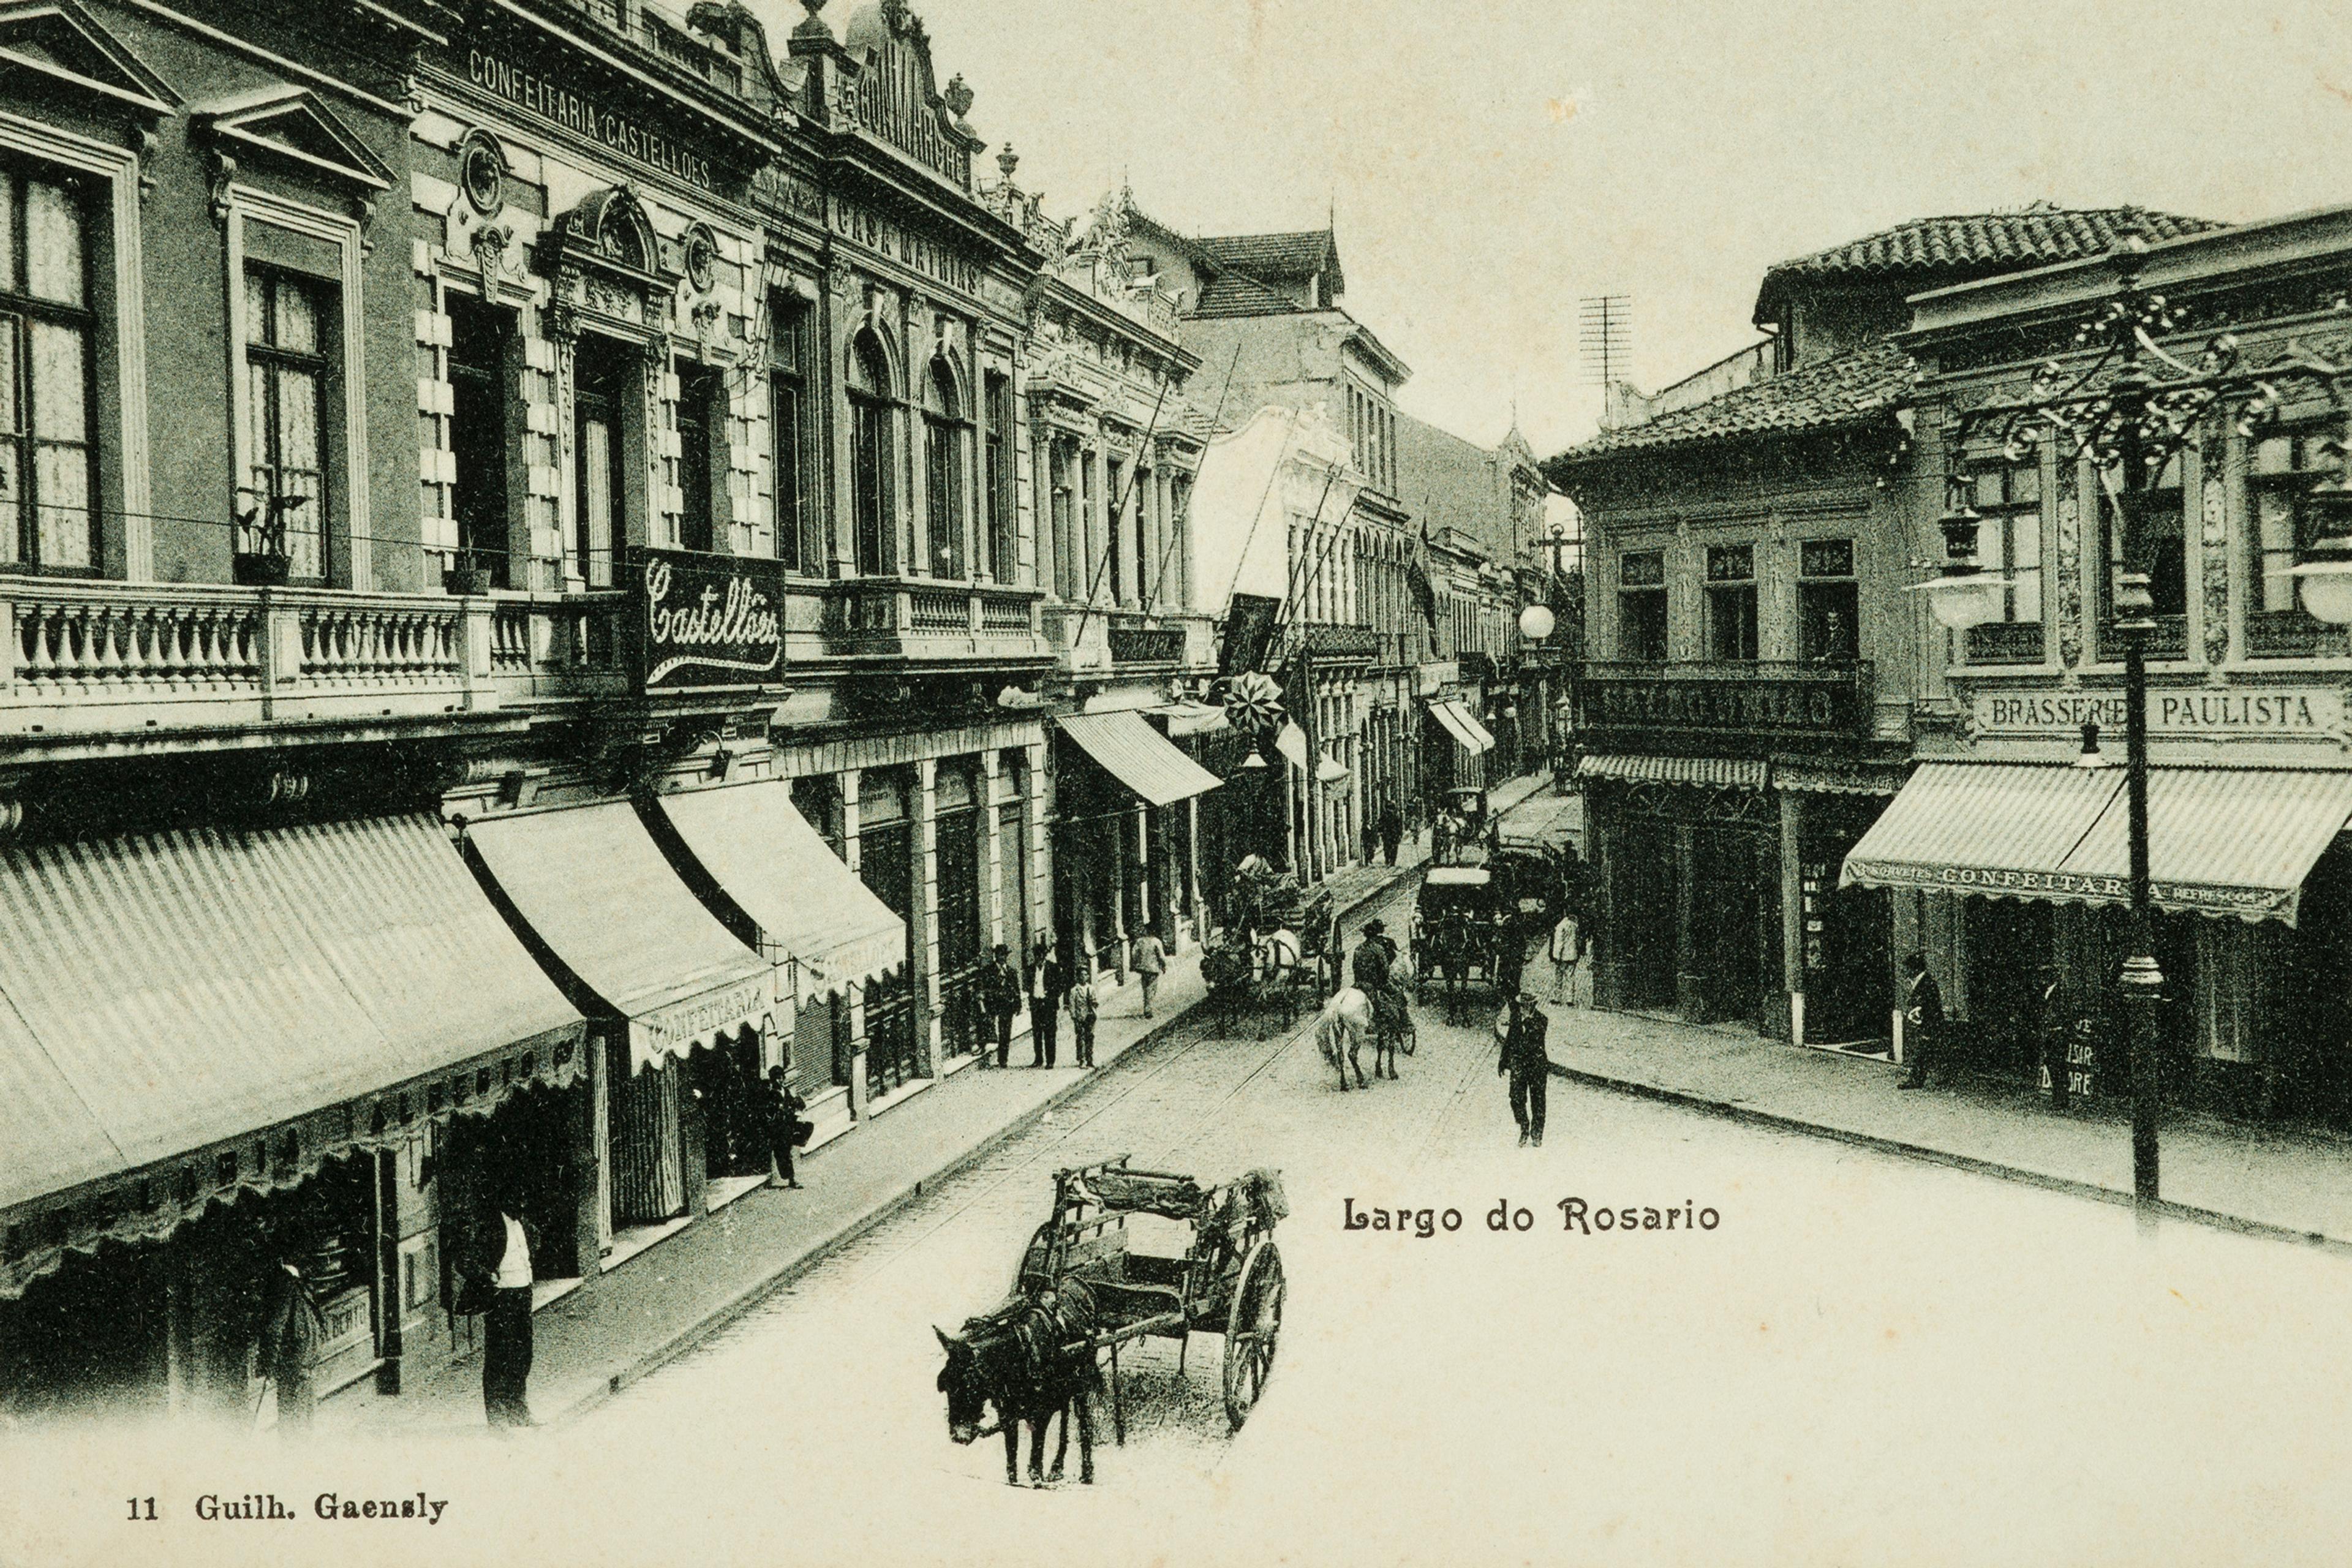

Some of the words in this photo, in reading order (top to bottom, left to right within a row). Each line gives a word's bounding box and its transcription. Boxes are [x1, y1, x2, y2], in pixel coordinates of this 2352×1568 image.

[469, 48, 599, 138] CONFEITARIA
[605, 115, 710, 189] CASTELLOES
[1992, 698, 2128, 725] BRASSERIE
[2163, 696, 2315, 726] PAULISTA
[1942, 867, 2163, 901] CONFEITARA
